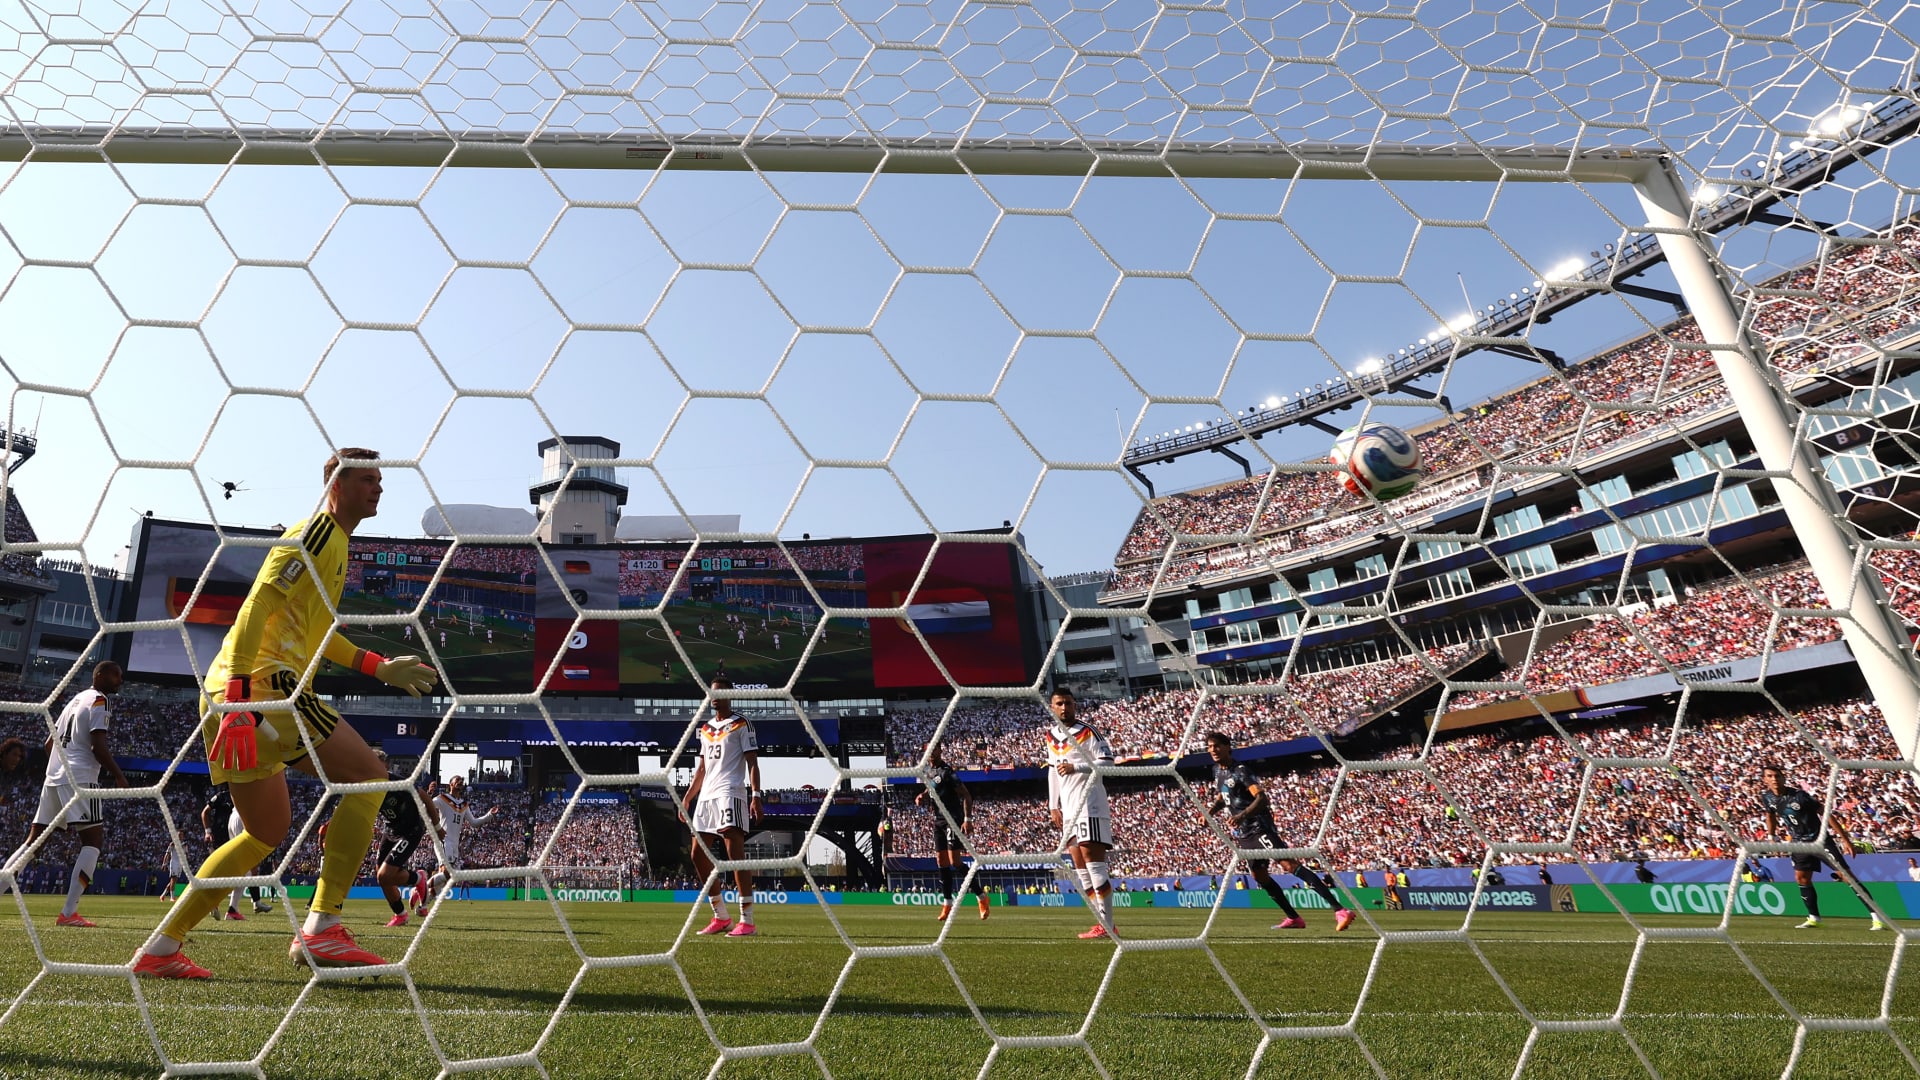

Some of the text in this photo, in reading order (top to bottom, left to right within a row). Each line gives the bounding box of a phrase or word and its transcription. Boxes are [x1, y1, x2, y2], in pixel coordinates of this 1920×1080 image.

[361, 553, 374, 561] GER
[632, 561, 658, 569] 41:20
[732, 682, 768, 690] isense
[708, 744, 722, 760] 23
[641, 791, 671, 800] BOSTON
[720, 808, 734, 826] 23
[1788, 814, 1799, 826] 6
[392, 839, 409, 854] 19
[1258, 834, 1274, 850] 15
[557, 889, 619, 901] aramco
[724, 890, 788, 904] armco
[1040, 894, 1065, 907] aramco
[1177, 891, 1217, 907] aramco
[1408, 892, 1431, 905] FIFA
[1431, 892, 1468, 905] WORLD
[1491, 891, 1533, 906] 2026
[1651, 884, 1786, 916] aramco
